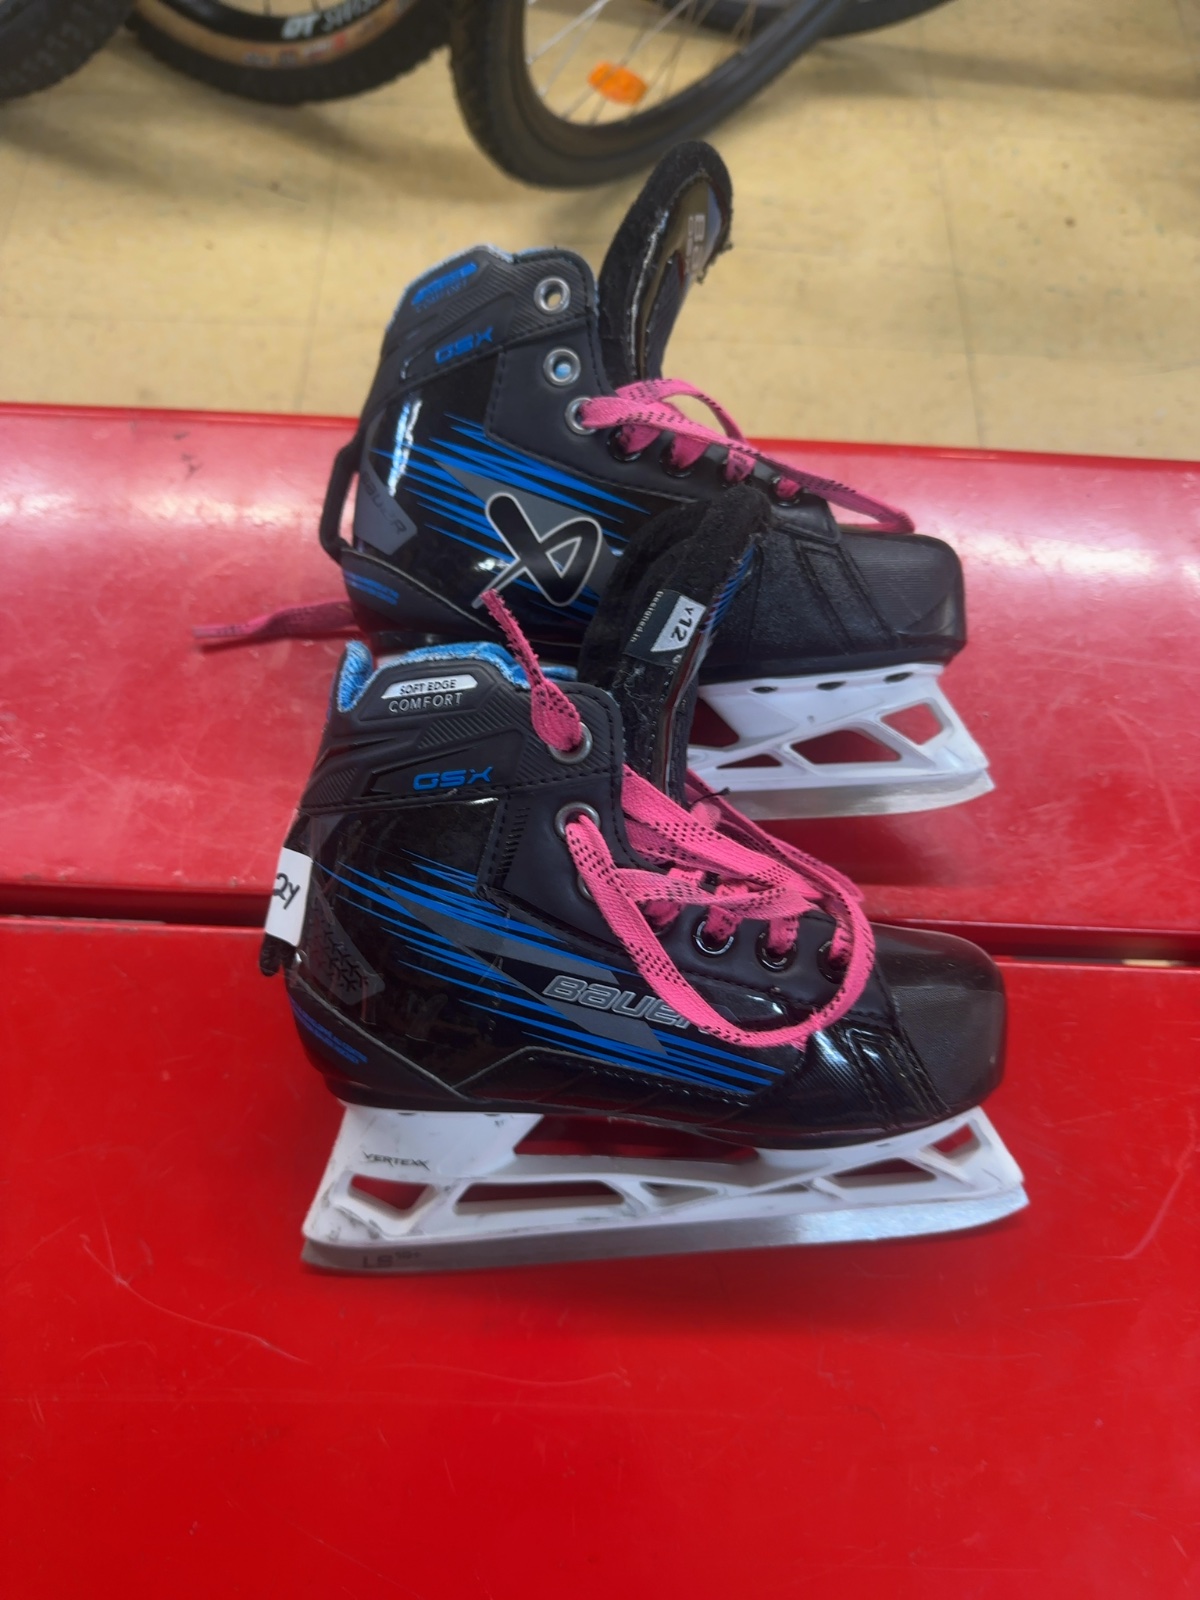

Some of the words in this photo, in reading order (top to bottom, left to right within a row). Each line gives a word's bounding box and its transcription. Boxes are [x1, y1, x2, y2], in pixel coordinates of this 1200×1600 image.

[281, 13, 320, 40] DT
[399, 684, 426, 696] SOFT
[427, 679, 458, 692] EDGE
[388, 692, 464, 714] COMFORT
[413, 765, 494, 791] GSX
[362, 1150, 431, 1172] VERTEXX
